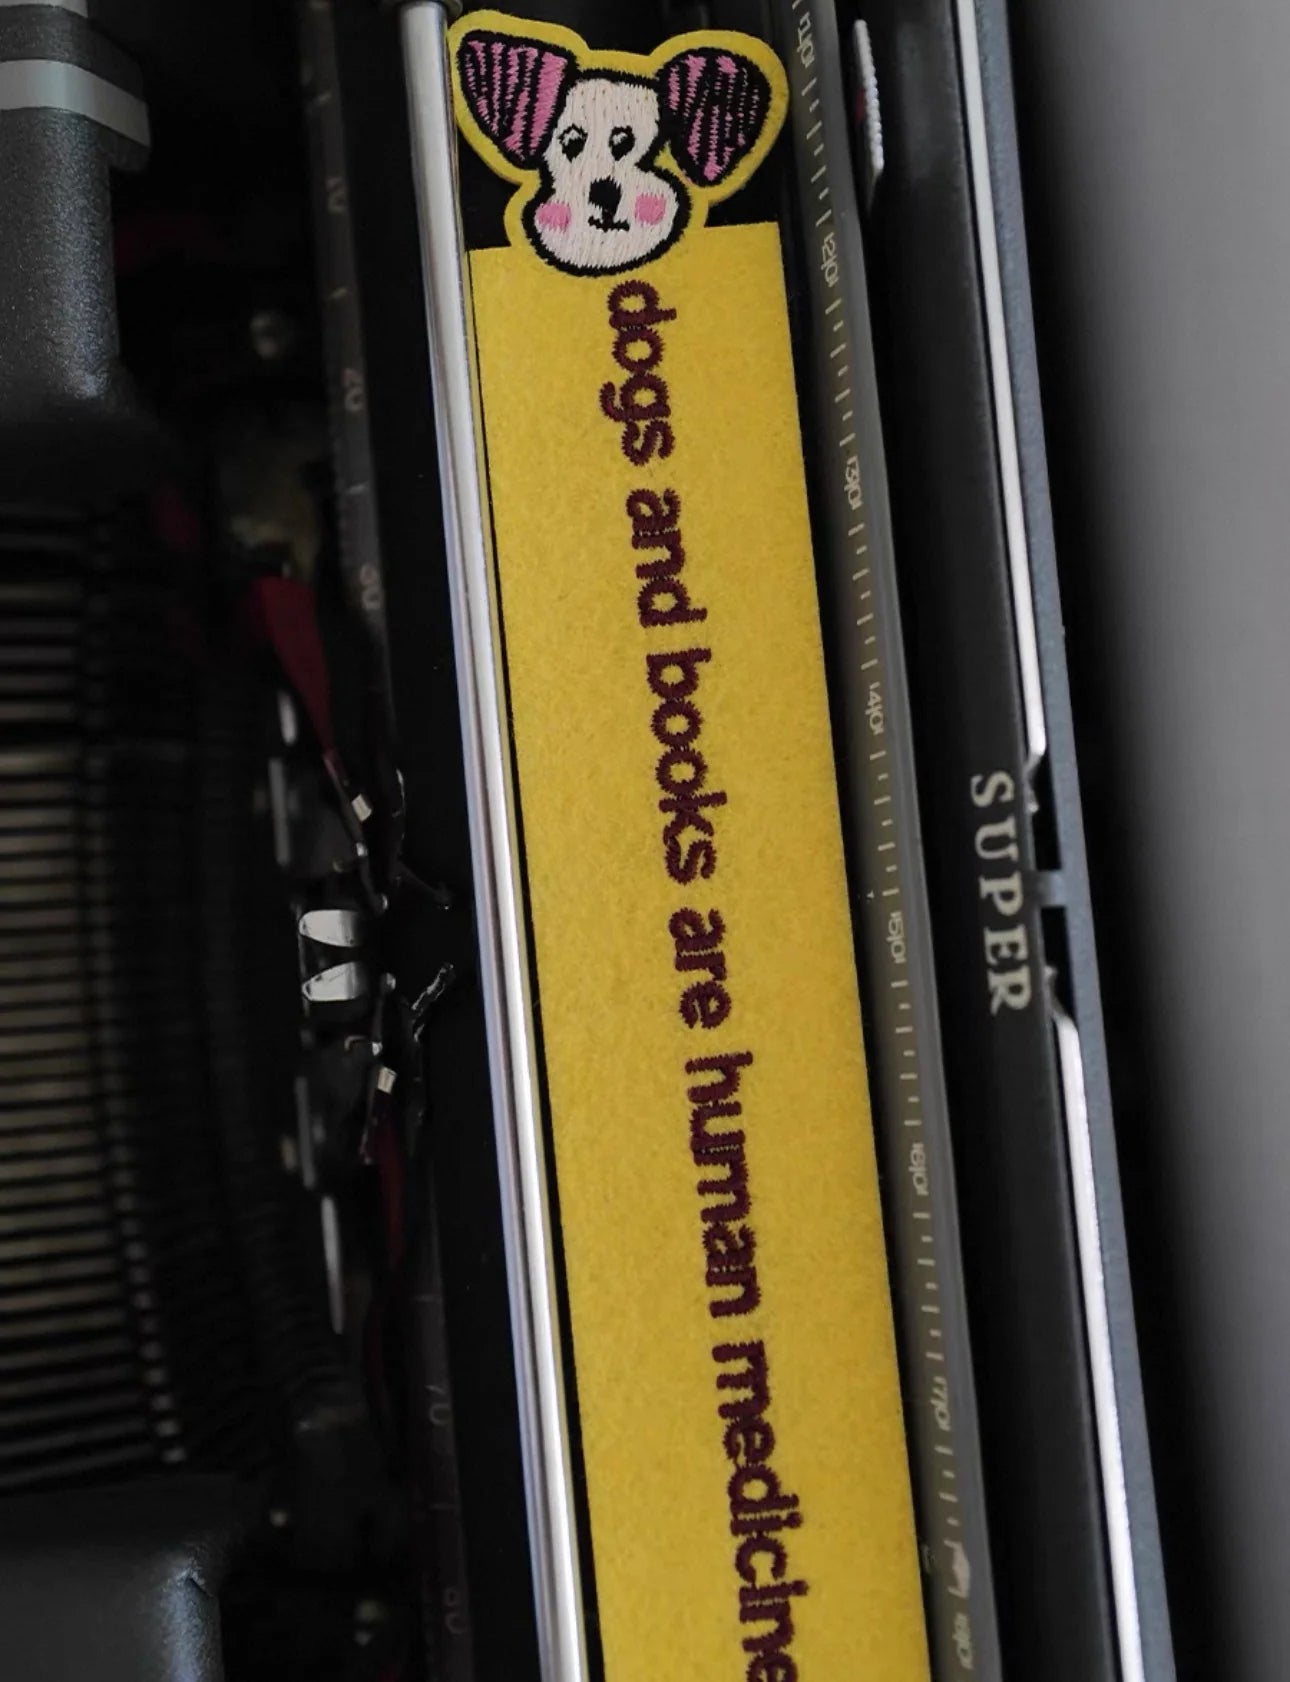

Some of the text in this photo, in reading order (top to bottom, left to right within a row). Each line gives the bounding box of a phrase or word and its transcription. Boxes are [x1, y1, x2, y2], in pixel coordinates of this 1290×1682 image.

[599, 280, 810, 1682] dogs and books are human medicine
[970, 770, 1032, 1015] SUPER
